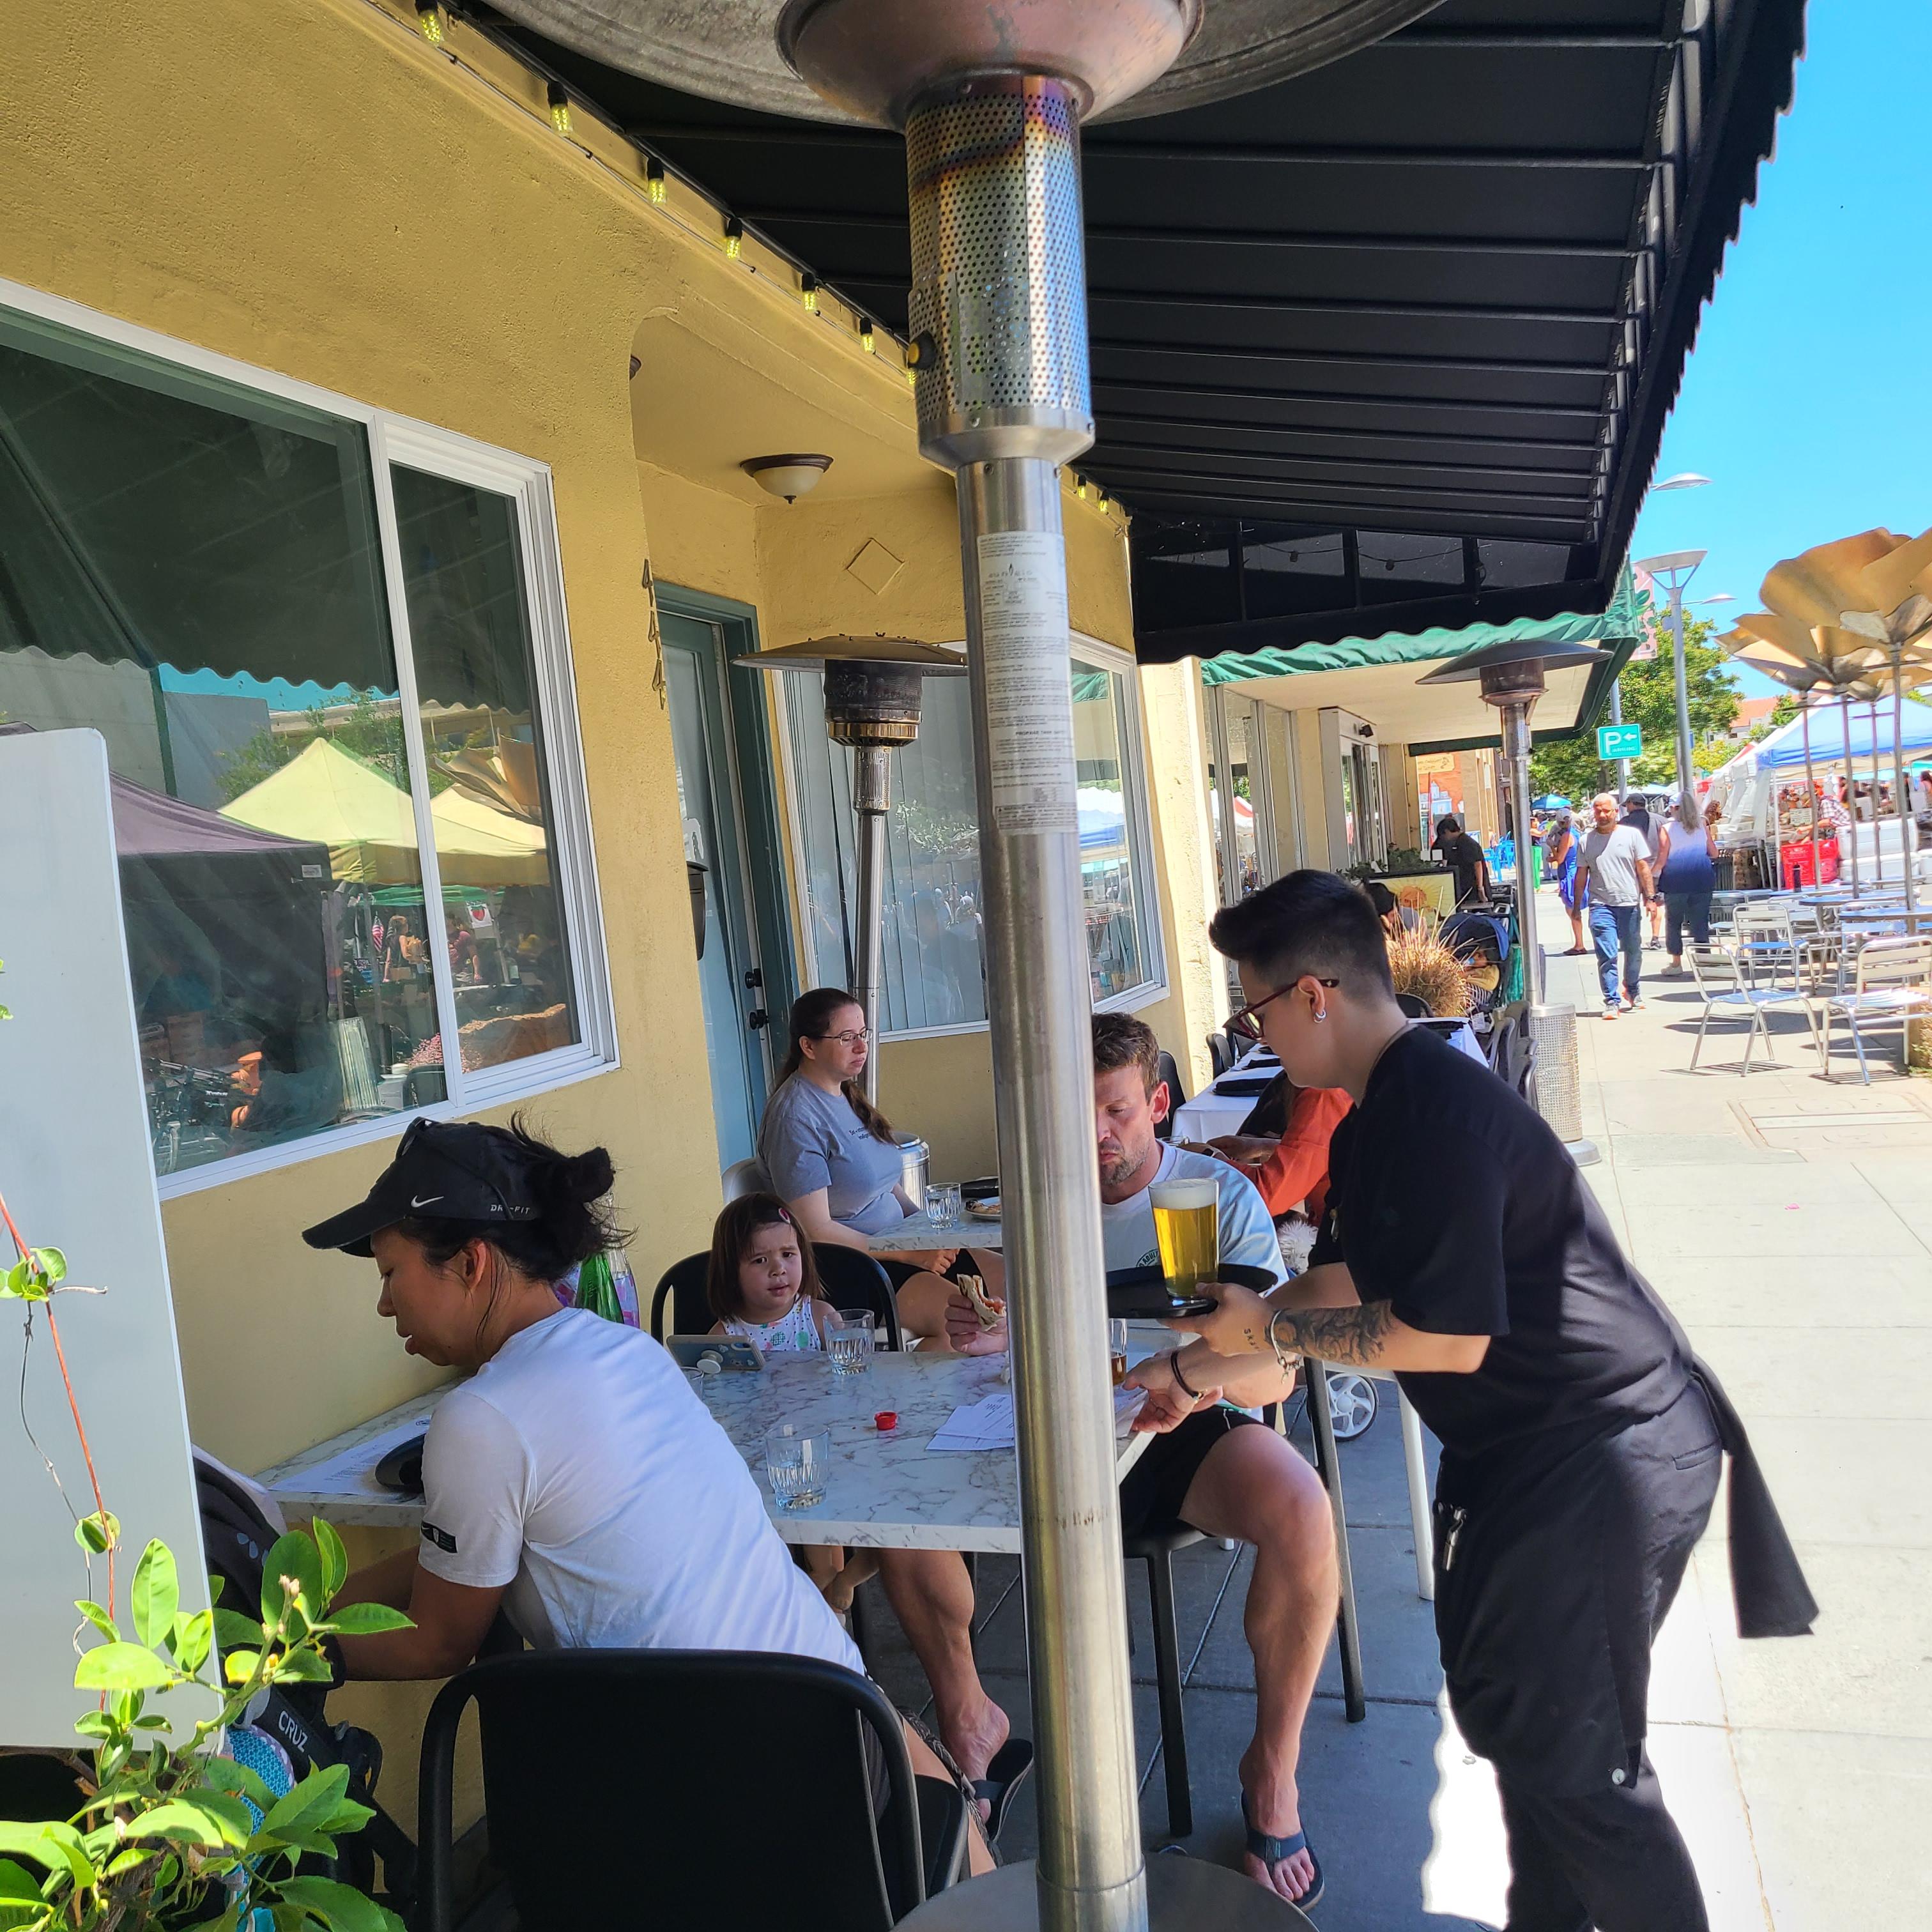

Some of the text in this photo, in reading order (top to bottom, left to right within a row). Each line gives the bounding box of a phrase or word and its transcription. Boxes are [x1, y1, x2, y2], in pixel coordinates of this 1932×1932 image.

[1604, 732, 1621, 754] P
[490, 1204, 530, 1215] DR-FIT
[279, 1710, 308, 1752] CRUZ
